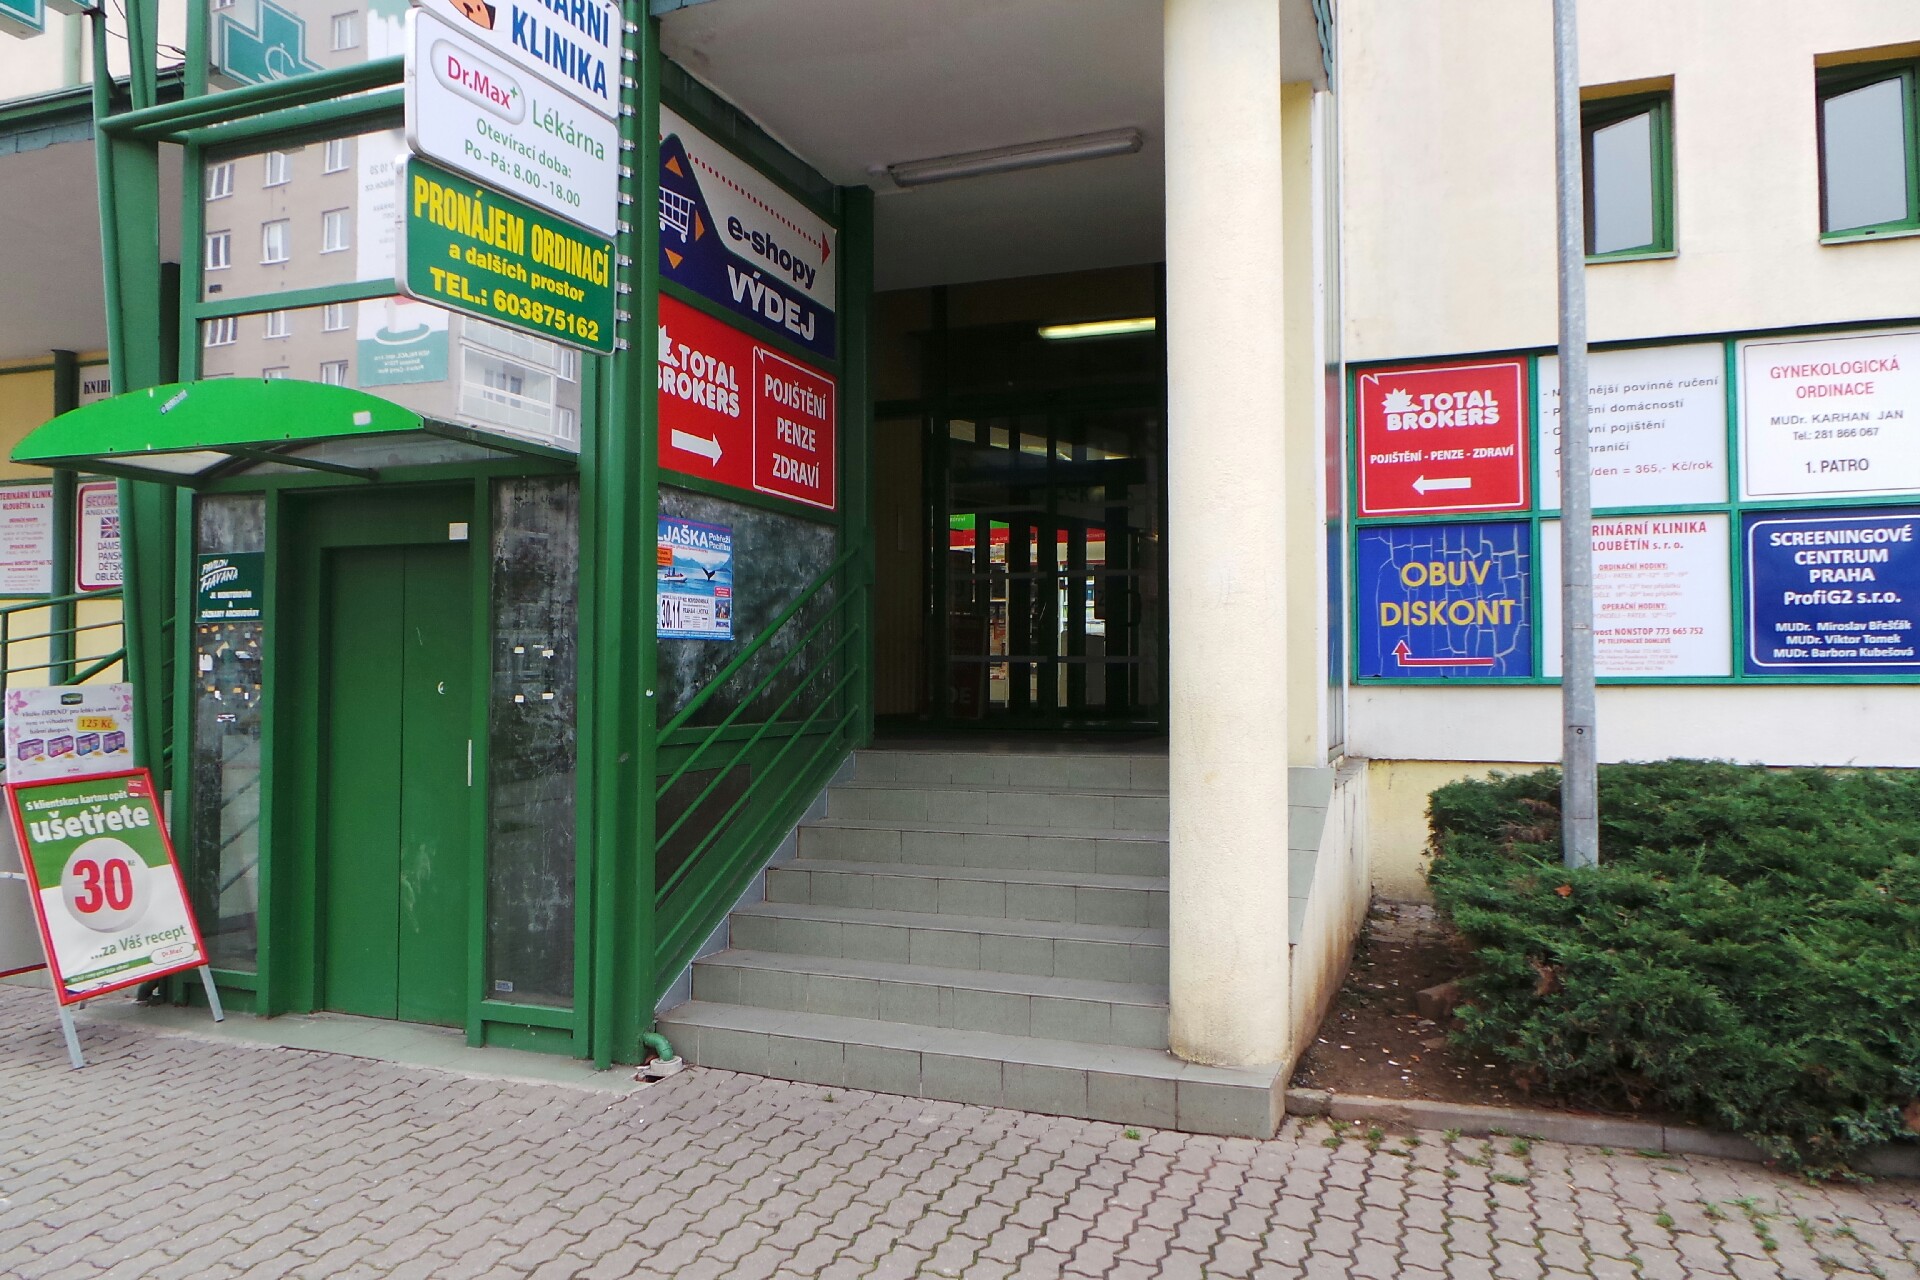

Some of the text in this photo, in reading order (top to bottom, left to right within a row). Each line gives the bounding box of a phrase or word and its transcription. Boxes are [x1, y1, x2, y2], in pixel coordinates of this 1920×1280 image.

[512, 4, 609, 100] KLINIKA
[447, 55, 511, 110] Dr.Max
[532, 99, 605, 161] Lékárna
[538, 152, 572, 179] doba:
[414, 175, 611, 289] PRONÁJEM ORDINACÍ
[727, 216, 816, 290] e-shopy
[449, 243, 585, 303] a dalších prostor
[430, 266, 599, 342] TEL.: 603875162
[727, 264, 816, 342] VÝDEJ
[678, 343, 739, 392] TOTAL
[1770, 354, 1901, 379] GYNEKOLOGICKÁ
[1623, 379, 1673, 394] povinné
[1678, 375, 1719, 389] ručení
[1796, 381, 1875, 399] ORDINACE
[764, 373, 827, 421] POJIŠTĚNÍ
[1420, 390, 1498, 412] TOTAL
[1387, 407, 1500, 431] BROKERS
[1611, 418, 1666, 434] pojištění
[1770, 410, 1904, 426] MUDr. KARHAN JAN
[777, 416, 816, 453] PENZE
[1814, 429, 1833, 440] 281
[1859, 427, 1879, 437] 067
[1370, 449, 1422, 464] POJIŠTĚNÍ
[1431, 449, 1464, 461] PENZE
[1472, 444, 1514, 459] ZDRAVÍ
[1672, 460, 1713, 471] Kč/rok
[1805, 457, 1869, 474] 1. PATRO
[772, 452, 820, 489] ZDRAVÍ
[658, 525, 709, 549] JAŠKA
[1592, 521, 1708, 536] RINÁRNÍ KLINIKA
[1770, 524, 1912, 547] SCREENINGOVÉ
[1592, 539, 1649, 551] LOUBĚTÍN
[1794, 548, 1889, 566] CENTRUM
[200, 568, 238, 593] HAVANA
[1401, 560, 1491, 587] OBUV
[1809, 567, 1876, 584] PRAHA
[1784, 589, 1902, 606] ProfiG2 s.r.o.
[1380, 600, 1516, 627] DISKONT
[1615, 627, 1653, 636] NONSTOP
[1656, 627, 1670, 635] 773
[1672, 627, 1687, 635] 665
[1689, 627, 1704, 635] 752
[1775, 622, 1812, 632] MUDr.
[1816, 621, 1867, 631] Miroslav
[1785, 634, 1901, 645] MUDr. Viktor Tomek
[1773, 646, 1914, 658] MUDr. Barbora Kubešová
[81, 719, 97, 729] 125
[30, 804, 150, 843] ušetřete
[72, 858, 134, 914] 30
[119, 935, 142, 951] Váš
[145, 925, 187, 945] recept
